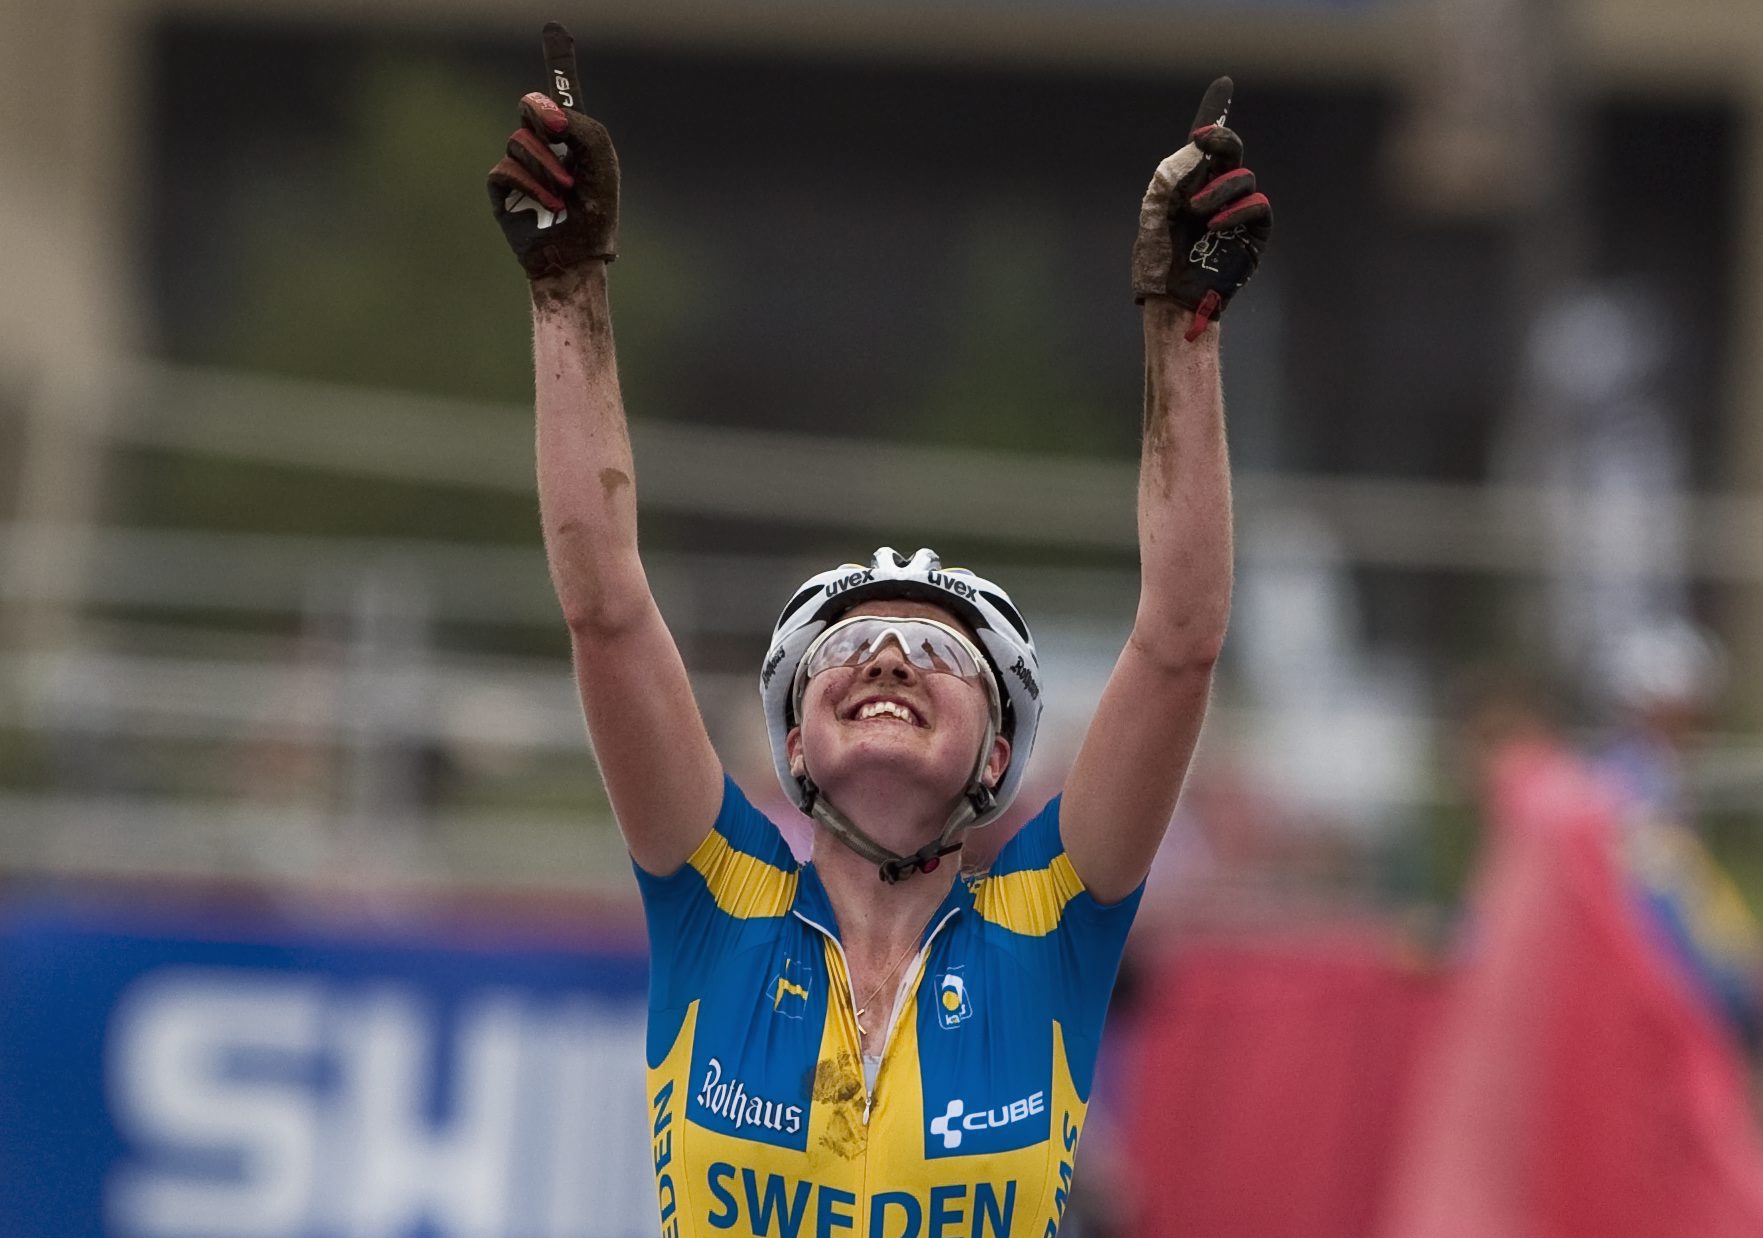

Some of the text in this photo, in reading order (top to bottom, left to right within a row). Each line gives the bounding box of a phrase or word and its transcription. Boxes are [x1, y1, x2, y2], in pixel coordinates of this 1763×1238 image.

[825, 568, 875, 598] uvex
[927, 569, 978, 601] uvex
[697, 1057, 802, 1134] Rothaus
[963, 1090, 1045, 1130] CUBE
